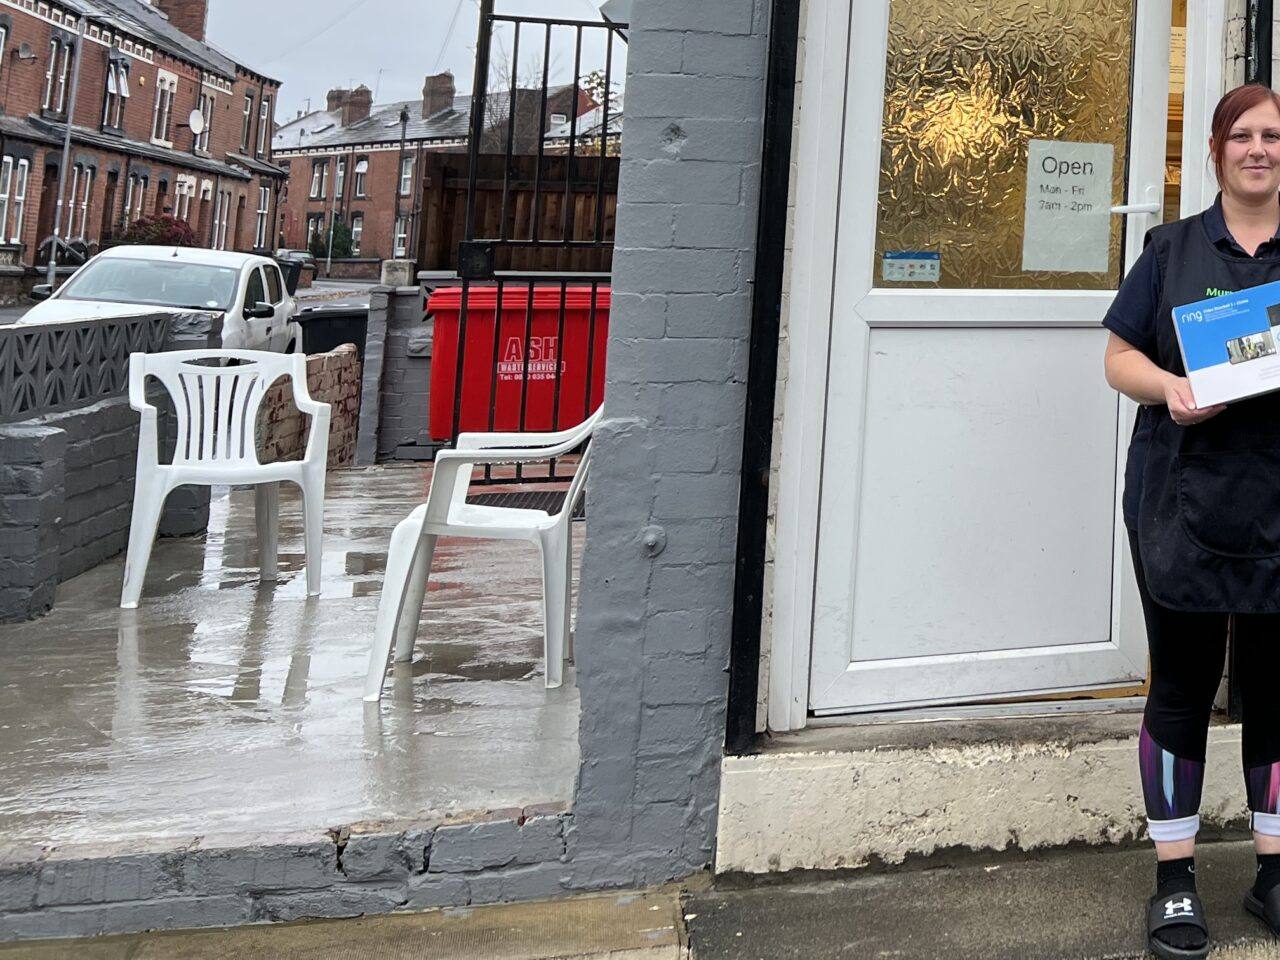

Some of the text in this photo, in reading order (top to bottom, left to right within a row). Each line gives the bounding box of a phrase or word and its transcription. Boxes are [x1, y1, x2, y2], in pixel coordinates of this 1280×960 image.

[1042, 156, 1094, 178] Open
[1040, 184, 1061, 194] Mon
[1072, 186, 1085, 195] Fri
[1039, 200, 1061, 210] 7am
[1071, 201, 1092, 212] 2pm
[1181, 310, 1203, 324] ring
[504, 336, 560, 361] ASH
